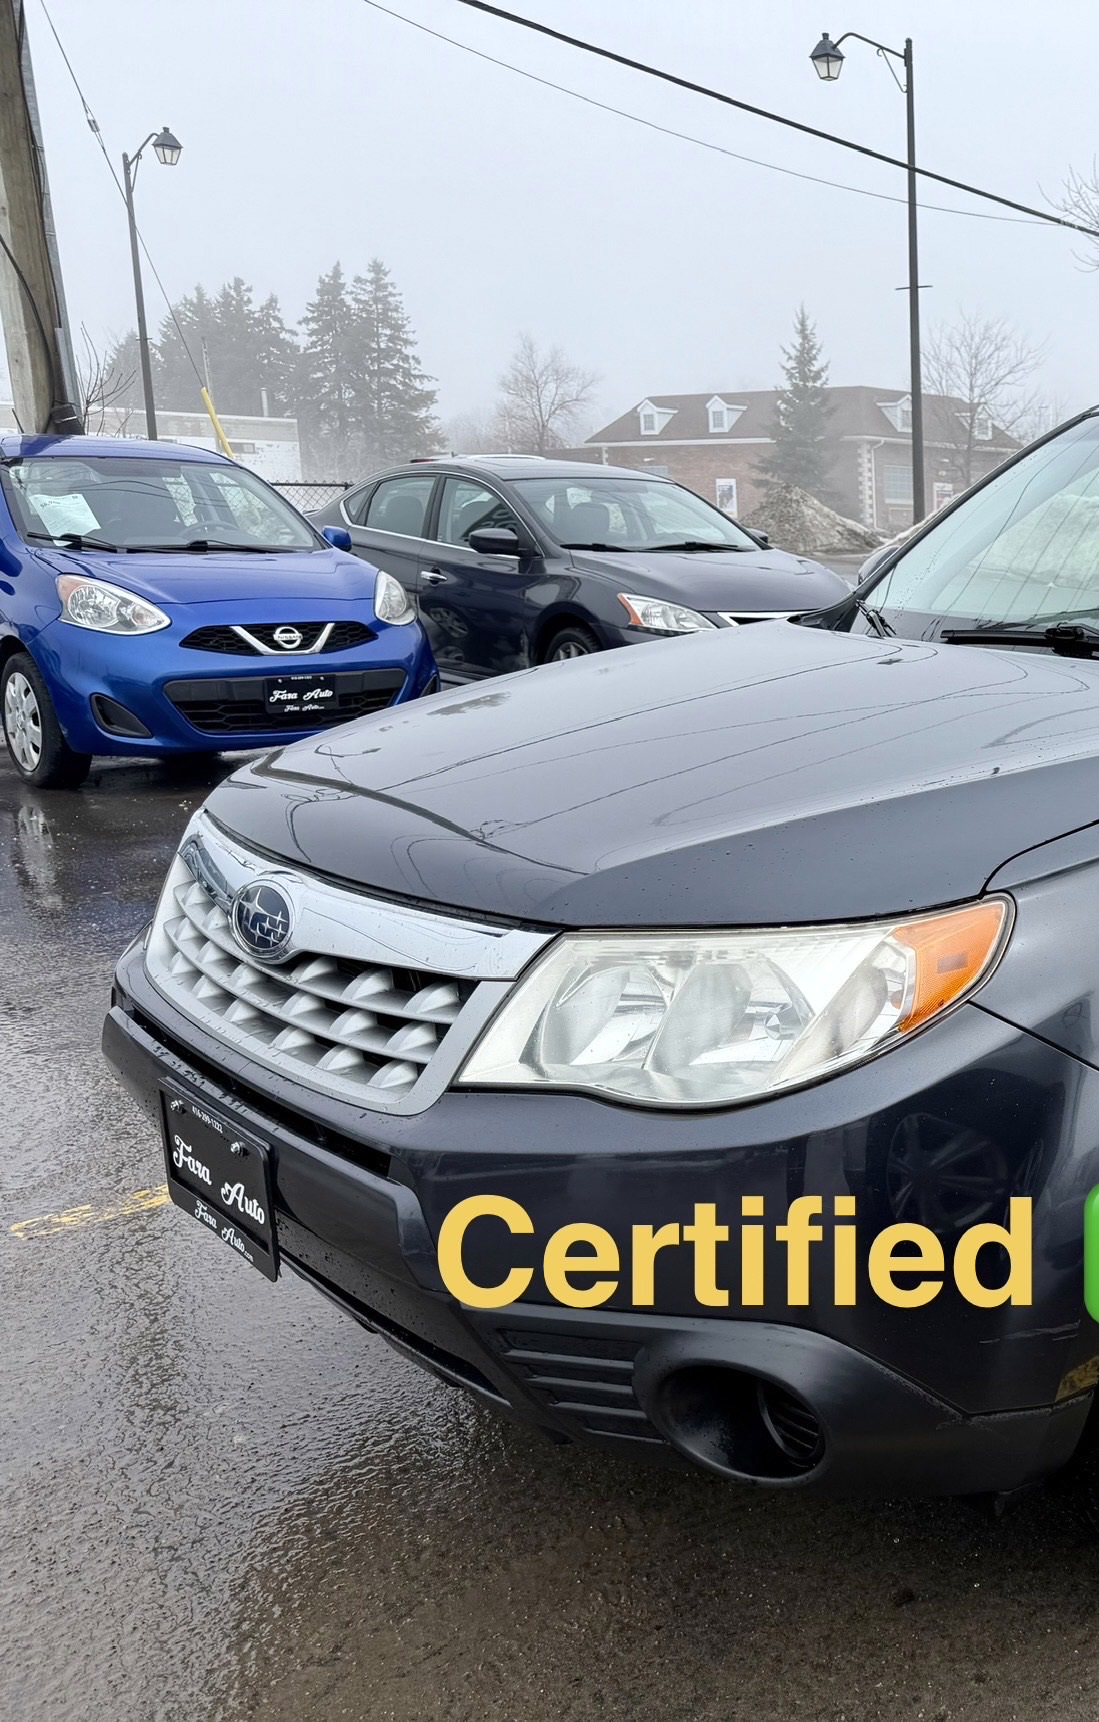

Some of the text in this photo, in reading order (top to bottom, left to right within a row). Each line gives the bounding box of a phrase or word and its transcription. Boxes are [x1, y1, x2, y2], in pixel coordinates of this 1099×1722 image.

[303, 688, 333, 700] Auto
[173, 1135, 265, 1225] Fara Auto
[194, 1200, 217, 1229] Fara
